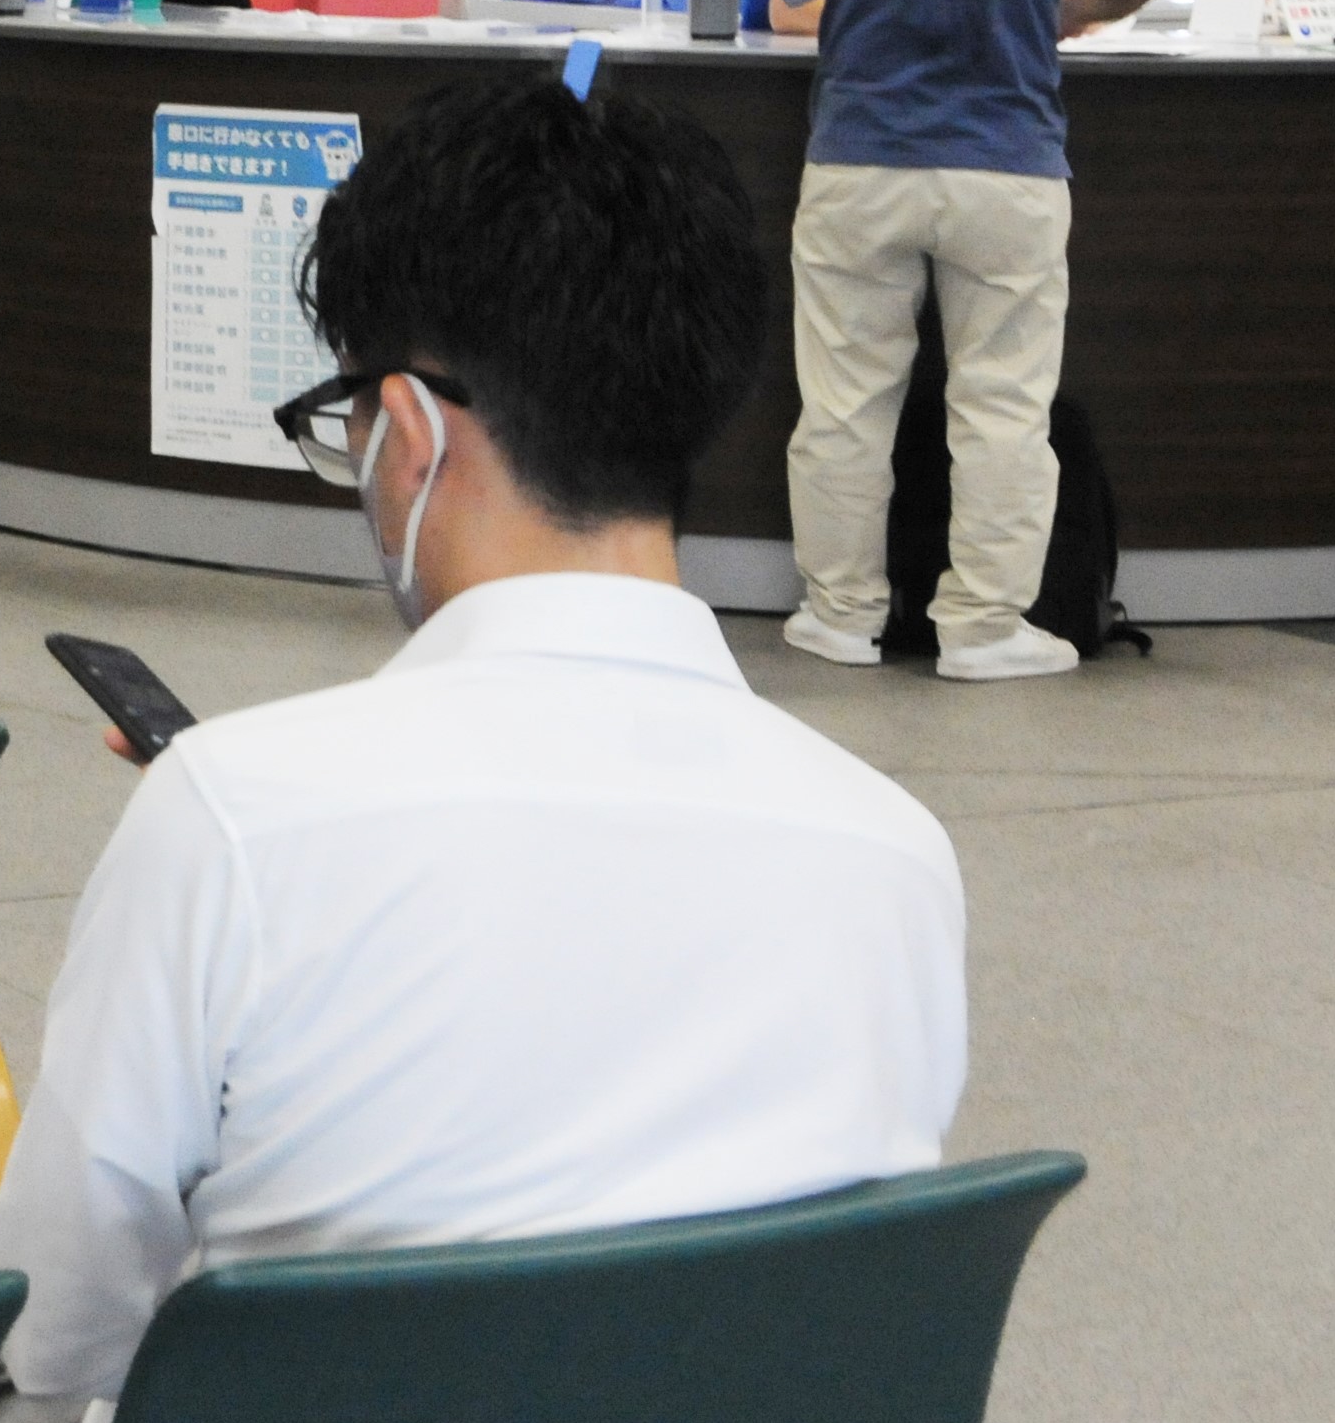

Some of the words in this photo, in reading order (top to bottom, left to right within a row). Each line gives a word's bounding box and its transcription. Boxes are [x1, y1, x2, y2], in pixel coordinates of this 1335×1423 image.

[167, 122, 311, 151] 窓口に行かなくても
